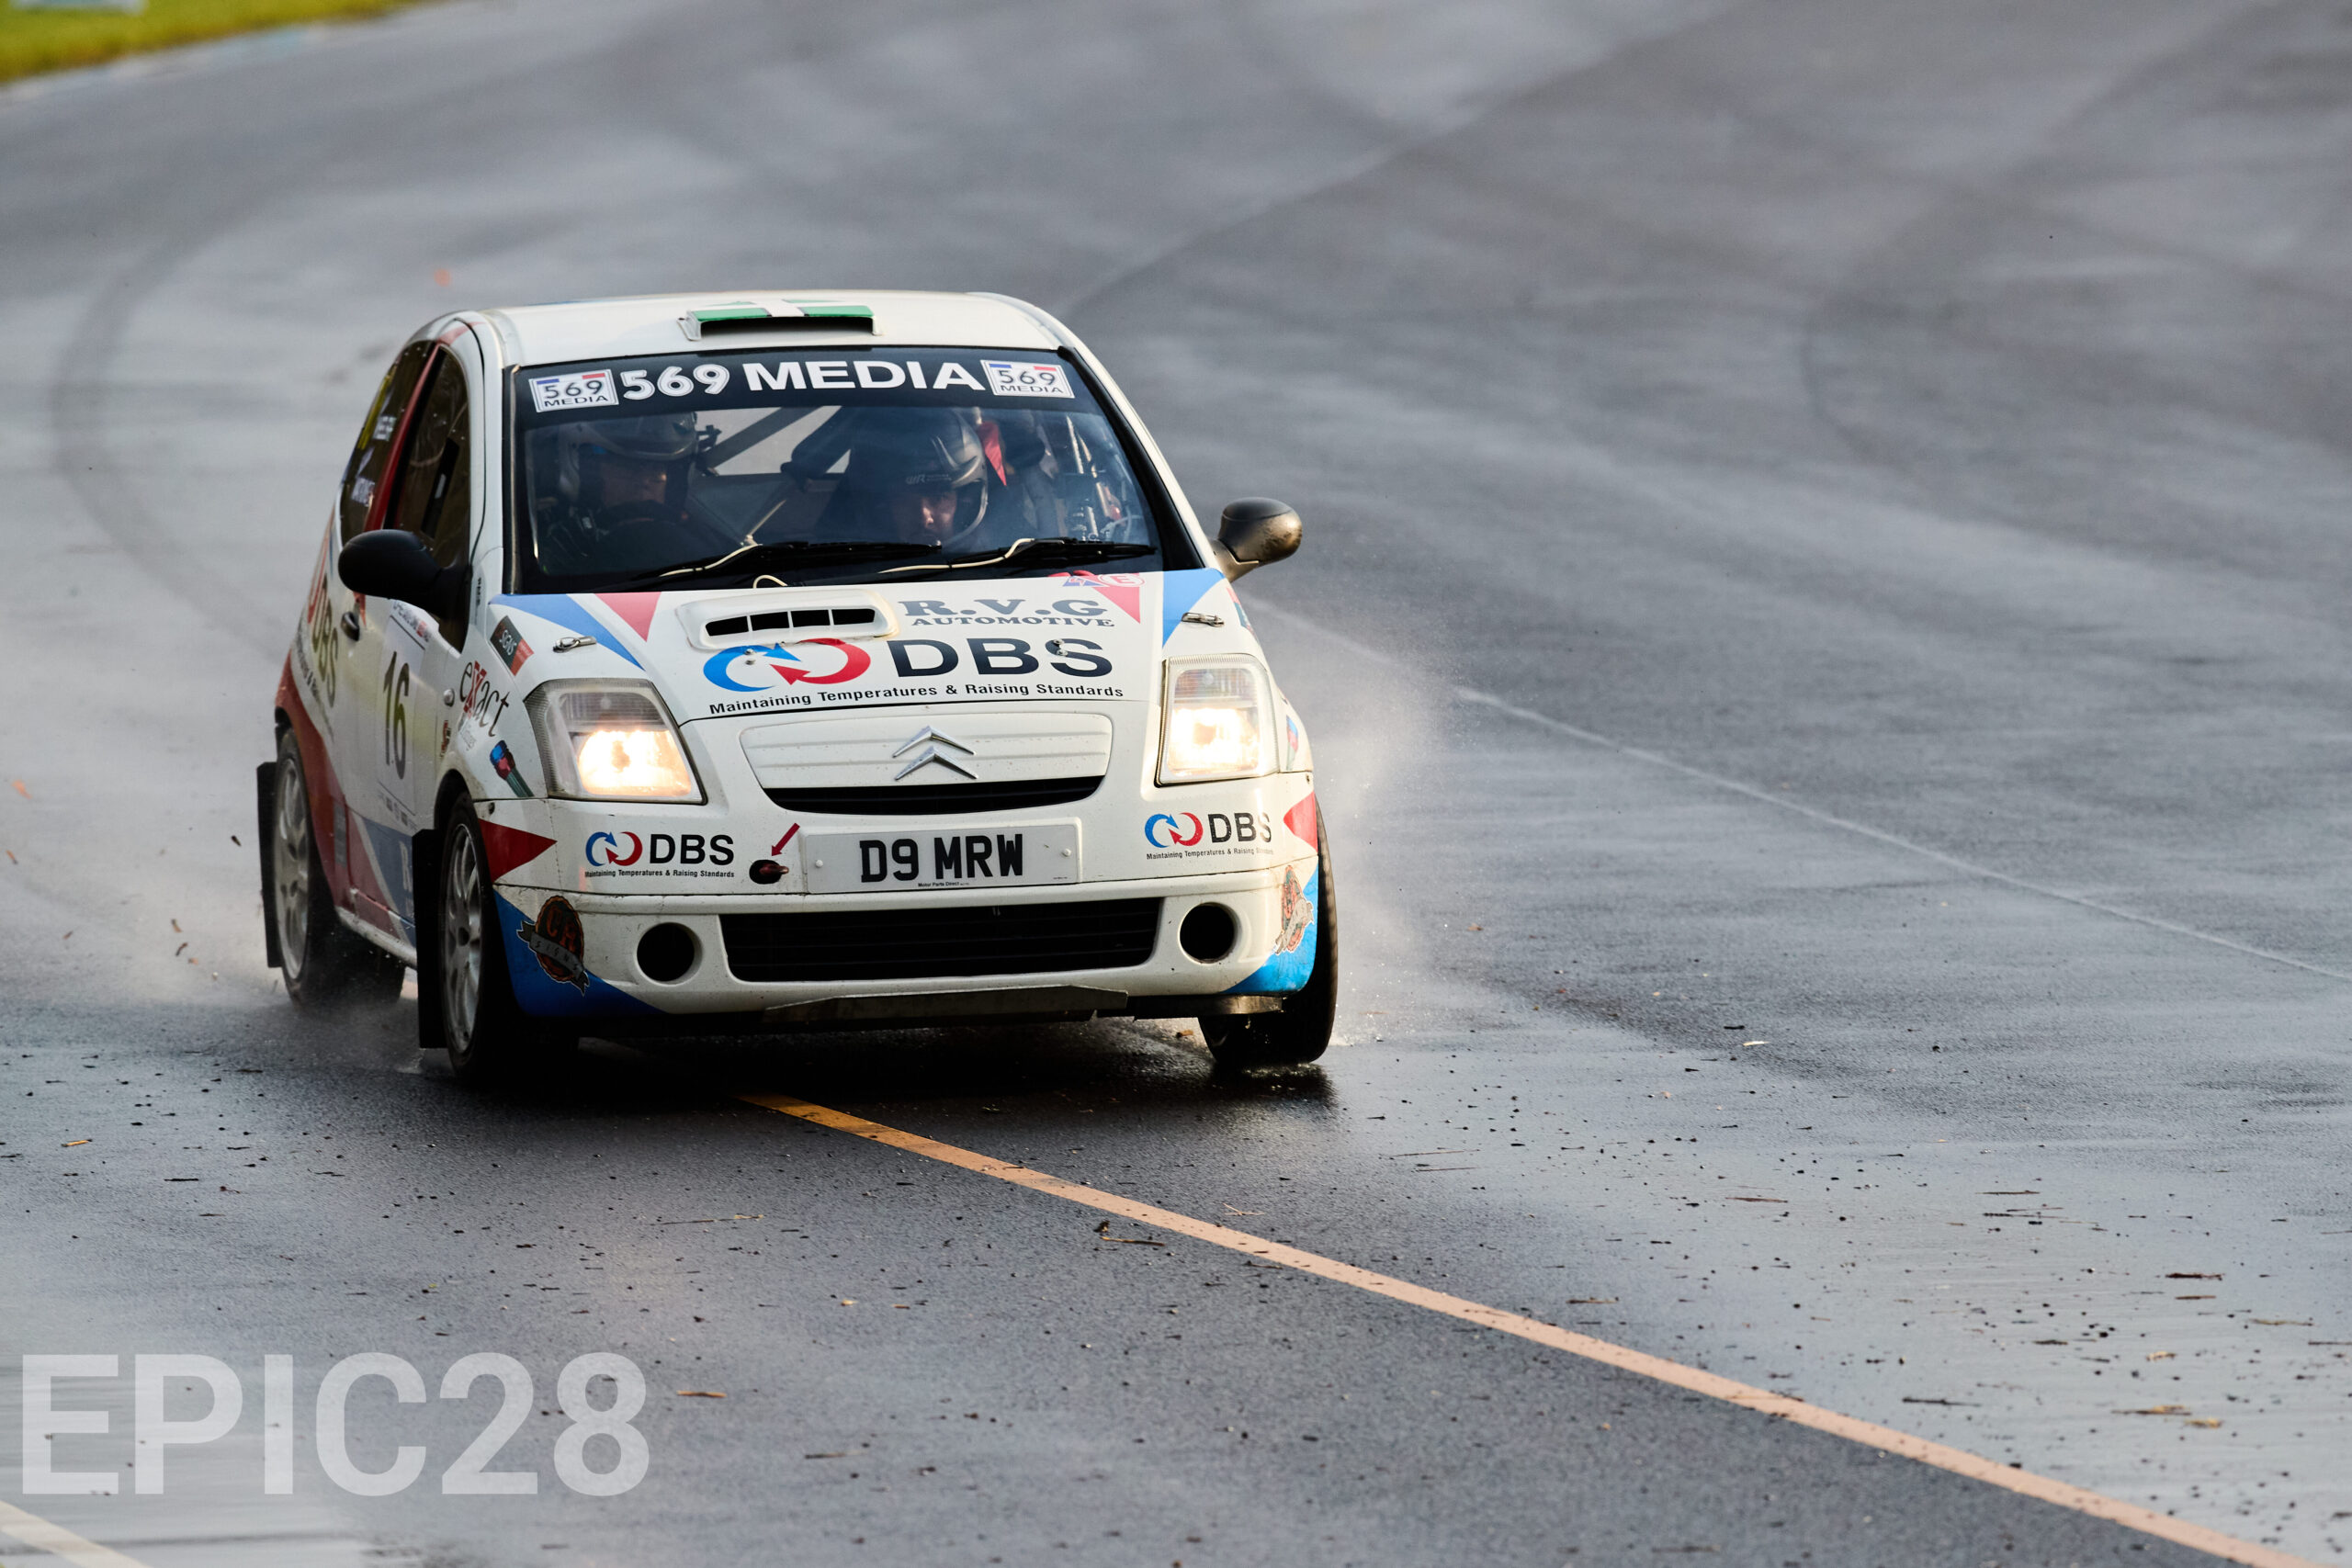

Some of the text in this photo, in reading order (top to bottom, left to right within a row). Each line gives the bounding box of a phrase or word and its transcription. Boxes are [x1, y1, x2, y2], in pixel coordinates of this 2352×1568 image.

[619, 361, 987, 400] 569 MEDIA
[997, 369, 1057, 386] 569
[543, 379, 604, 399] 569
[1000, 384, 1065, 394] MEDIA
[544, 394, 609, 408] MEDIA
[897, 599, 1108, 617] R.V.G
[910, 616, 1115, 627] AUTOMOTIVE
[886, 637, 1114, 678] DBS
[709, 683, 1124, 715] Maintaining Temperatures & Raising Standards
[383, 650, 410, 780] 16
[1207, 813, 1272, 843] DBS
[650, 833, 735, 866] DBS
[859, 833, 1023, 883] D9 MRW
[1147, 849, 1183, 860] Maintaining
[1184, 848, 1226, 857] Temperatures
[618, 869, 663, 877] Temperatures
[673, 869, 698, 878] Raising
[700, 870, 735, 878] Standards
